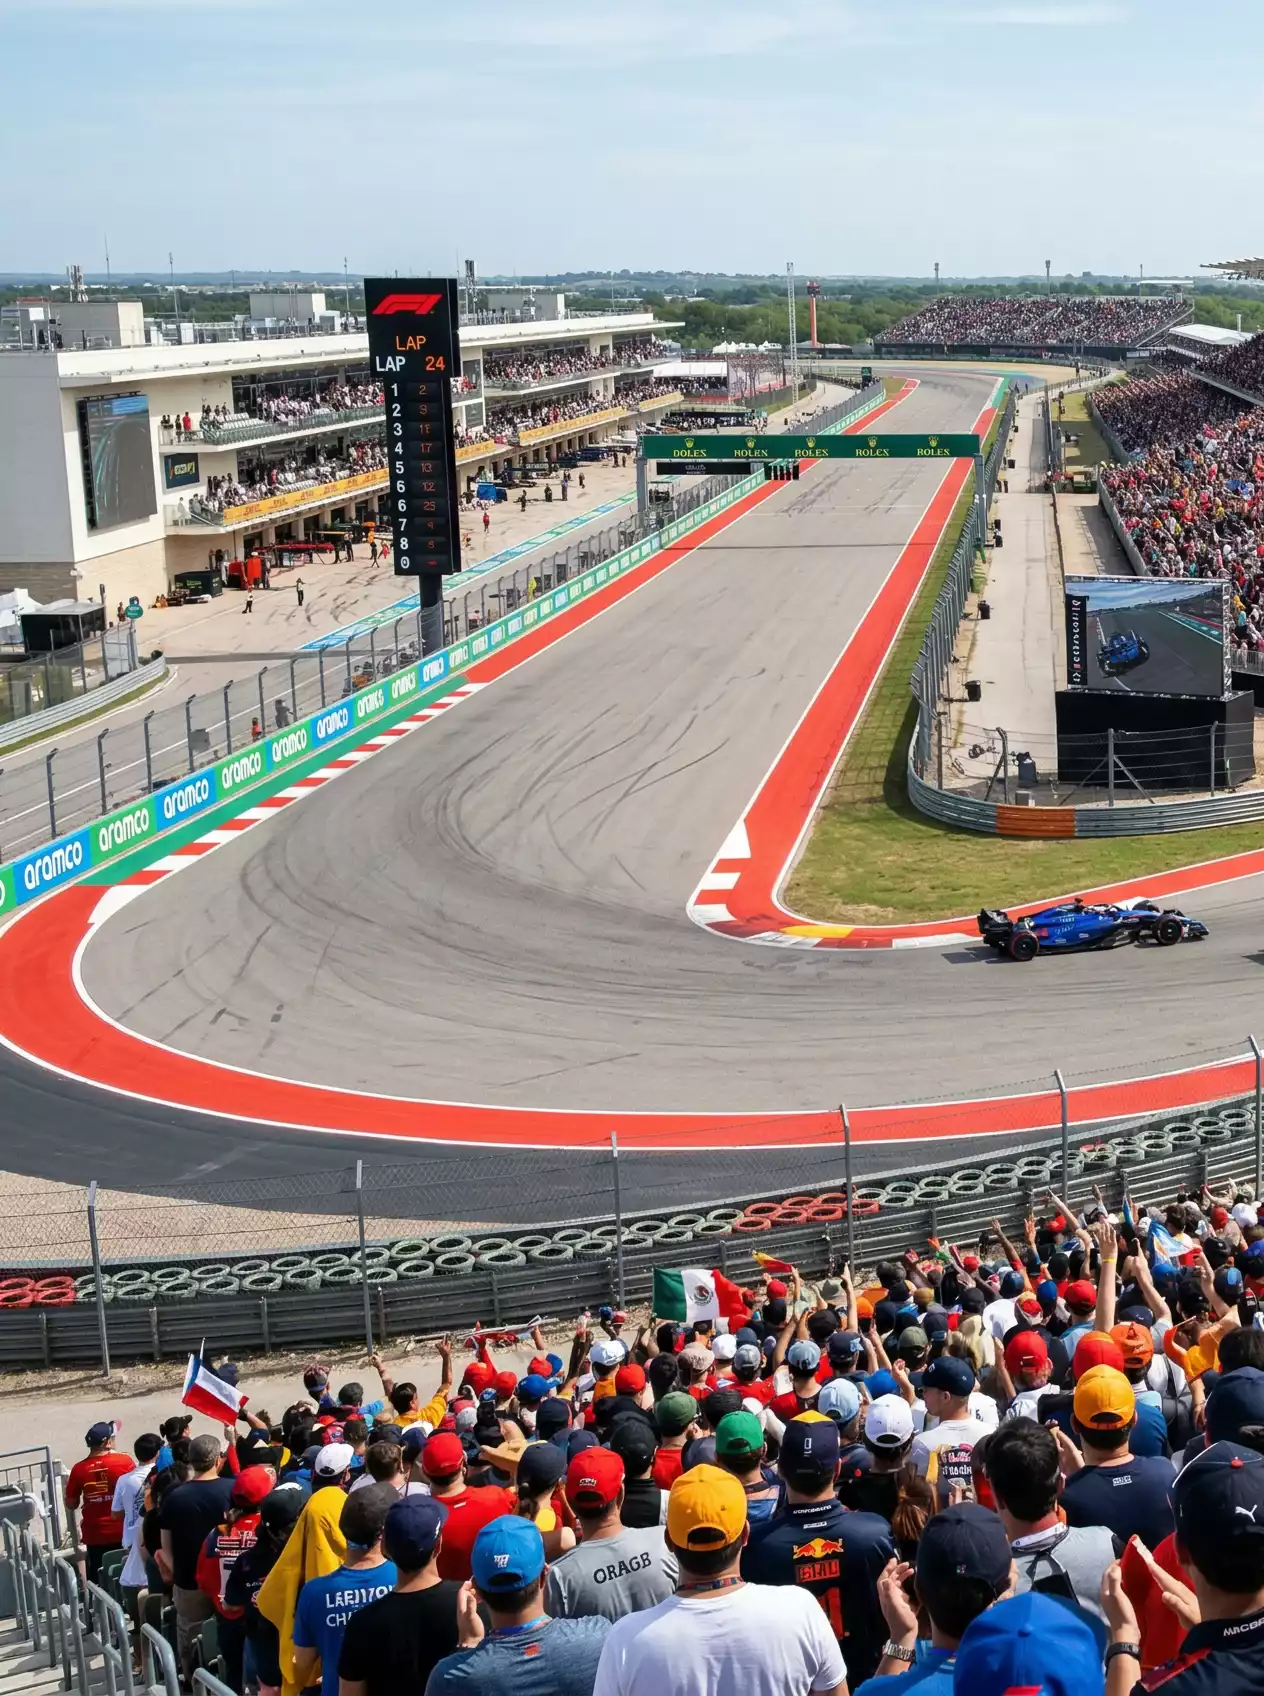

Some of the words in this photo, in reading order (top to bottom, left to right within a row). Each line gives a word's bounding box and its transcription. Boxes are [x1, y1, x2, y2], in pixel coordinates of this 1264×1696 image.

[395, 335, 426, 351] LAP
[375, 356, 406, 372] LAP
[425, 356, 445, 371] 24
[391, 383, 398, 397] 1
[392, 403, 401, 417] 2
[393, 423, 403, 436] 3
[394, 442, 404, 455] 4
[395, 461, 405, 474] 5
[396, 480, 406, 493] 6
[398, 499, 407, 512] 6
[398, 518, 407, 531] 7
[400, 537, 409, 550] 8
[317, 708, 348, 738] aramco
[272, 728, 307, 762] aramco
[222, 752, 261, 789] aramco
[163, 778, 209, 819] aramco
[99, 808, 149, 852] aramco
[24, 841, 82, 890] aramco
[593, 1552, 652, 1584] ORAGB
